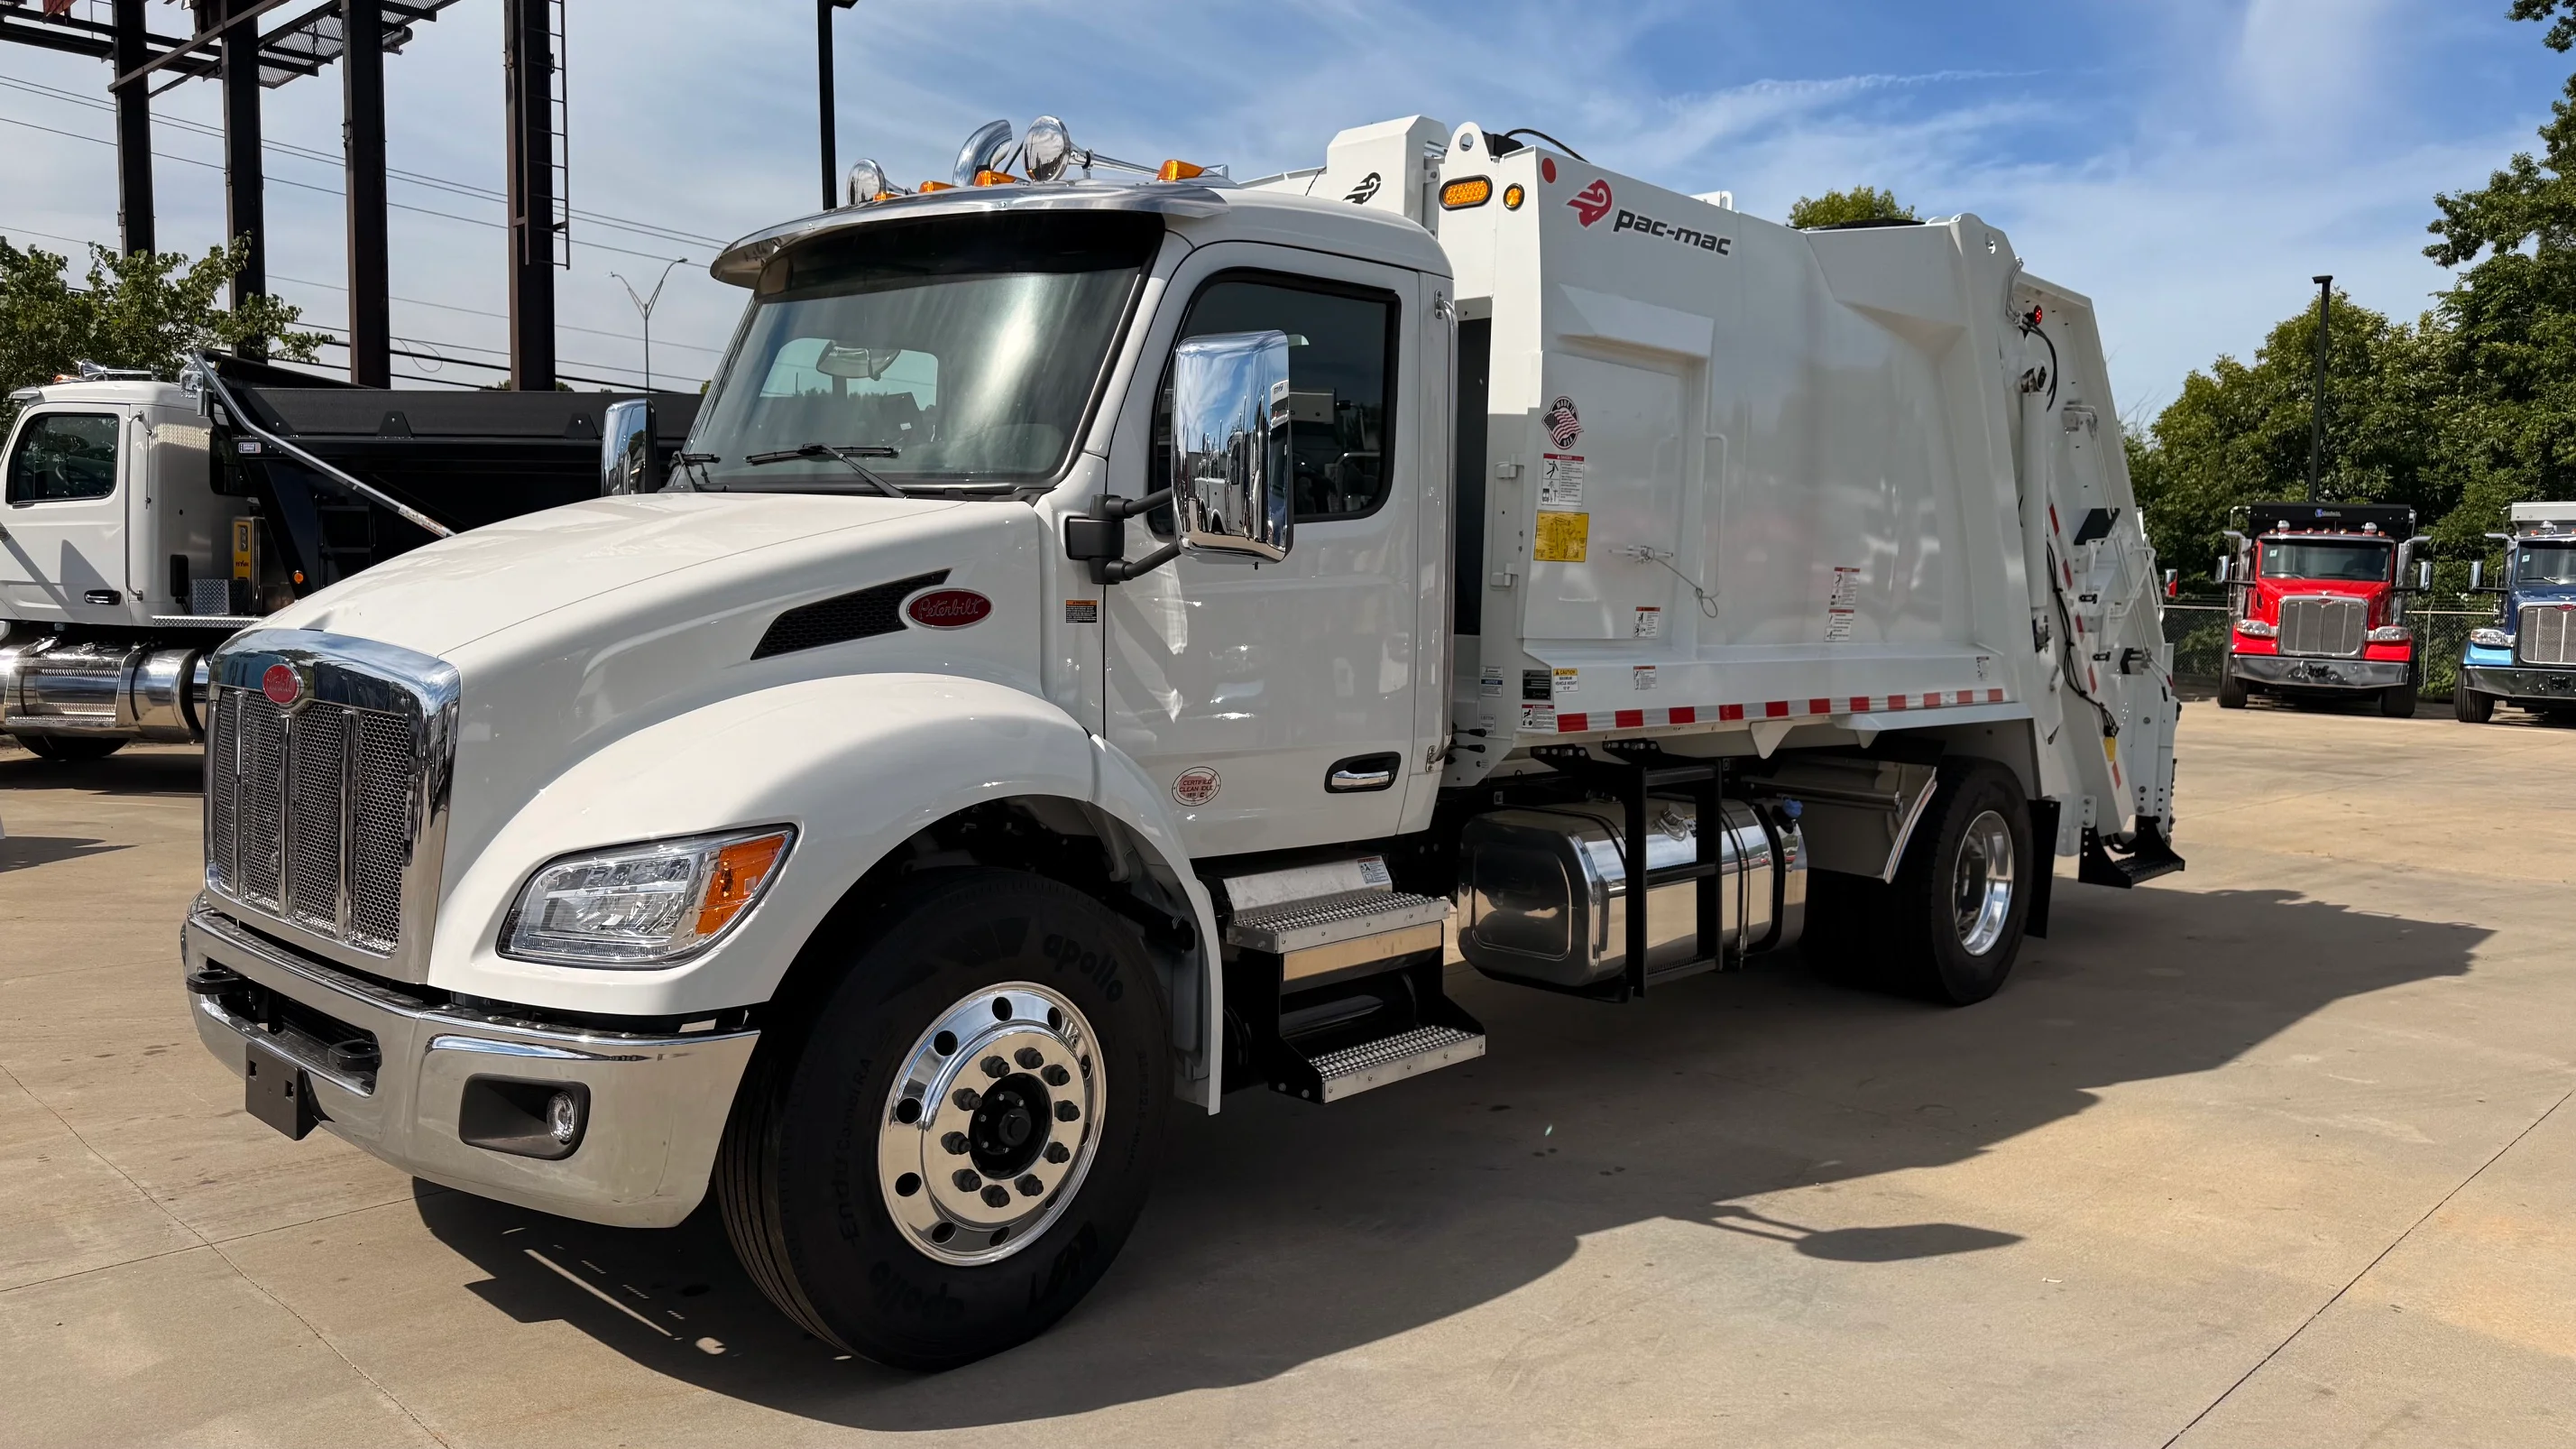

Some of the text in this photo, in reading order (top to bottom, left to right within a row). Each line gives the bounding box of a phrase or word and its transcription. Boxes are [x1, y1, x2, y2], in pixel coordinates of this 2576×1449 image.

[1613, 208, 1732, 256] pac-mac
[1556, 400, 1570, 410] MADE
[1563, 436, 1574, 447] USA
[917, 597, 984, 620] Peterbilt
[1042, 932, 1126, 1004] apollo
